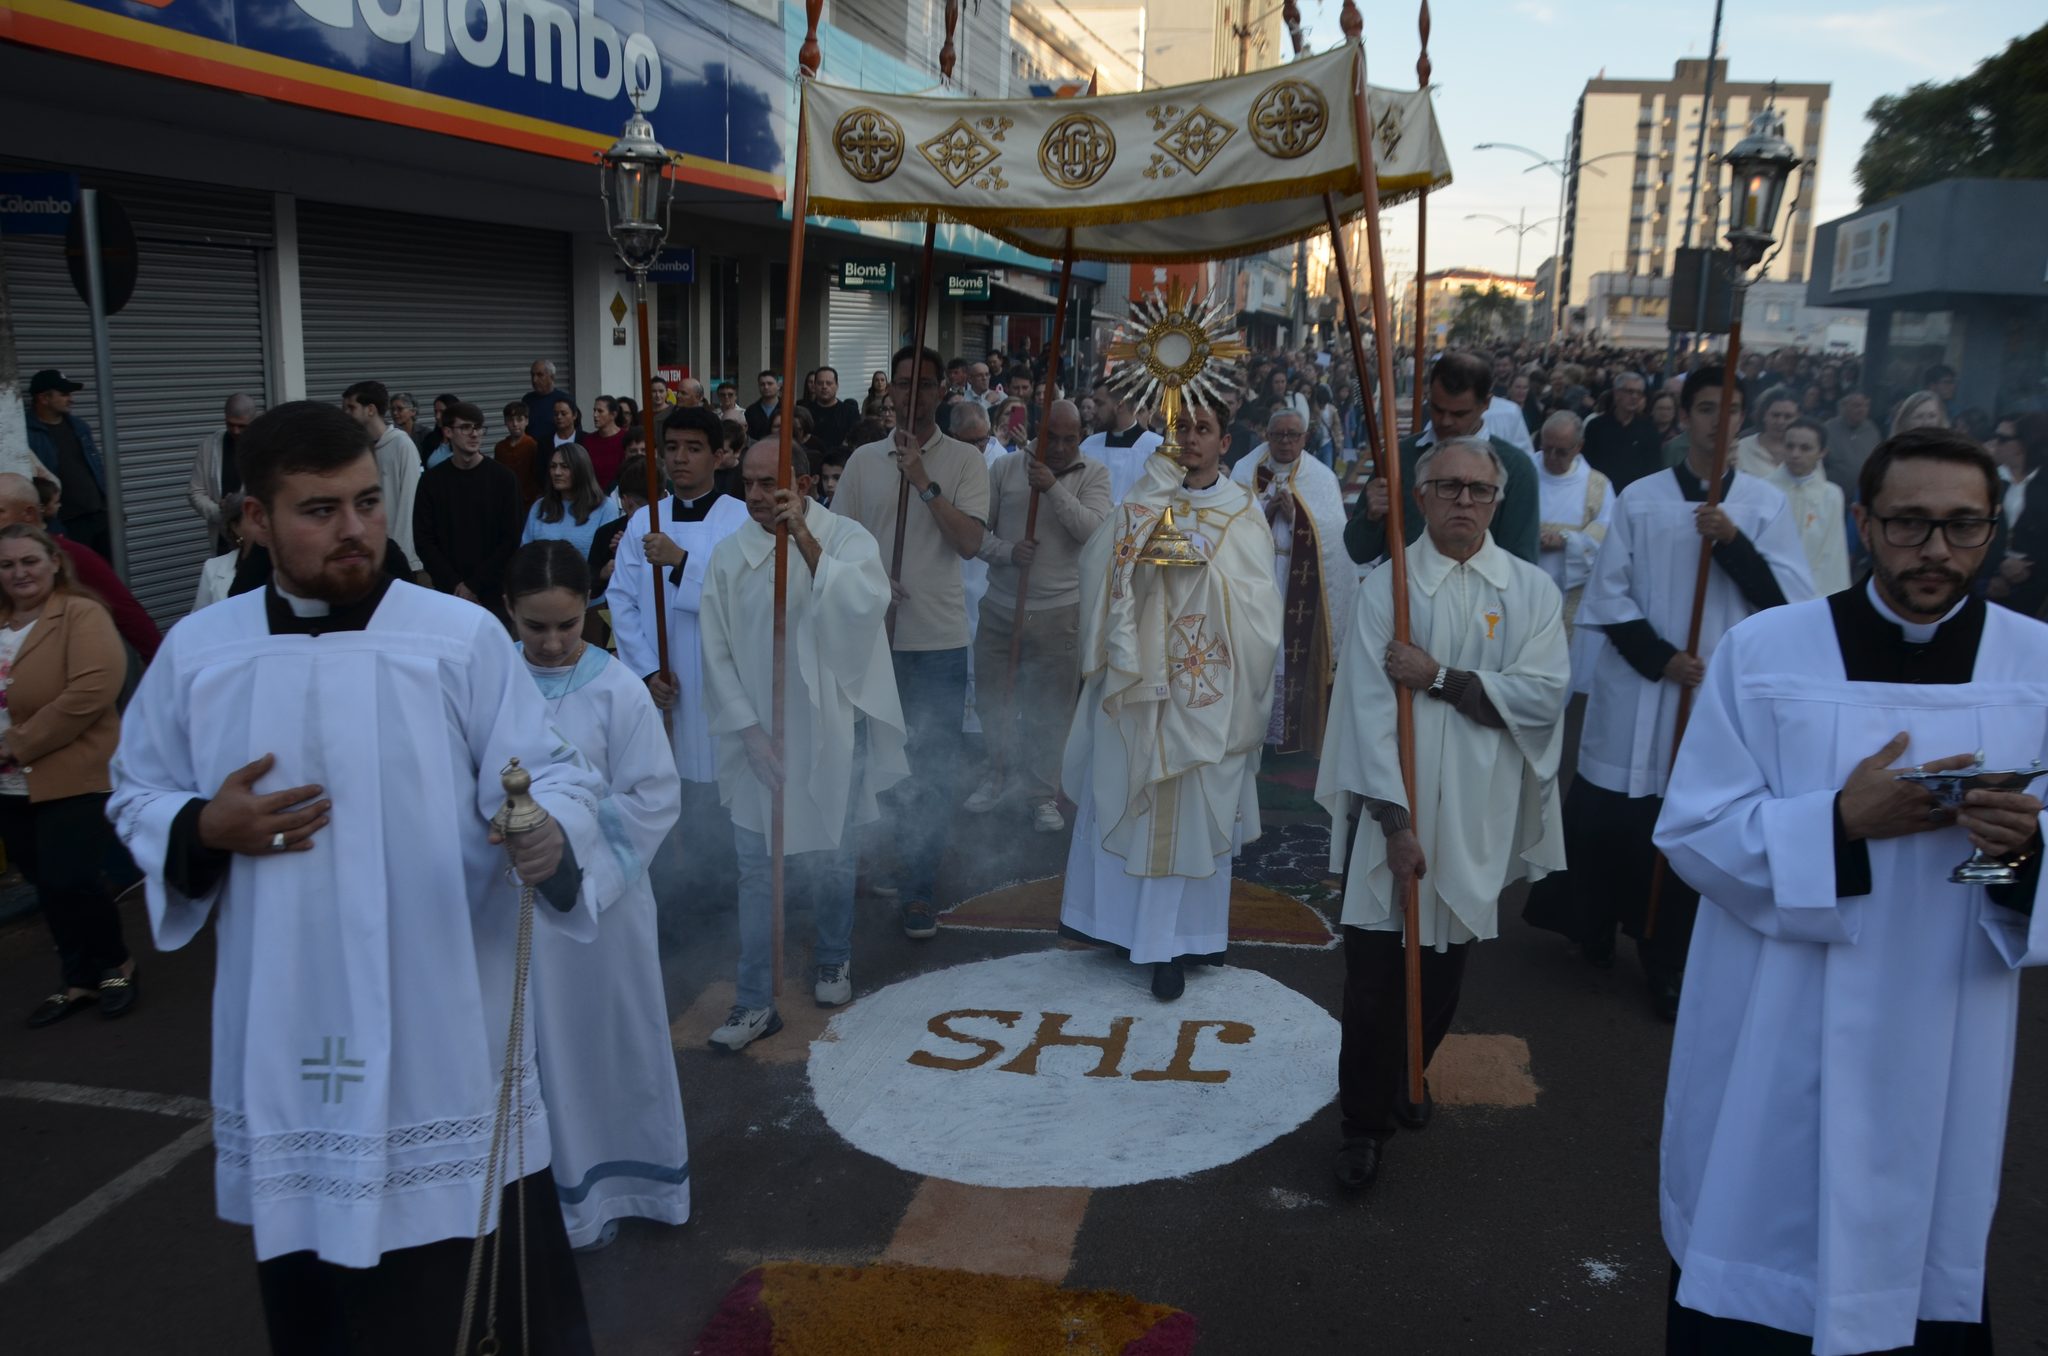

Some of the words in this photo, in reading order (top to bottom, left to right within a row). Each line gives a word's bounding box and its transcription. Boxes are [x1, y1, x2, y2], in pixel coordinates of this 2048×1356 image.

[293, 0, 661, 112] olombo
[0, 189, 72, 214] Colombo
[648, 259, 690, 271] olombo
